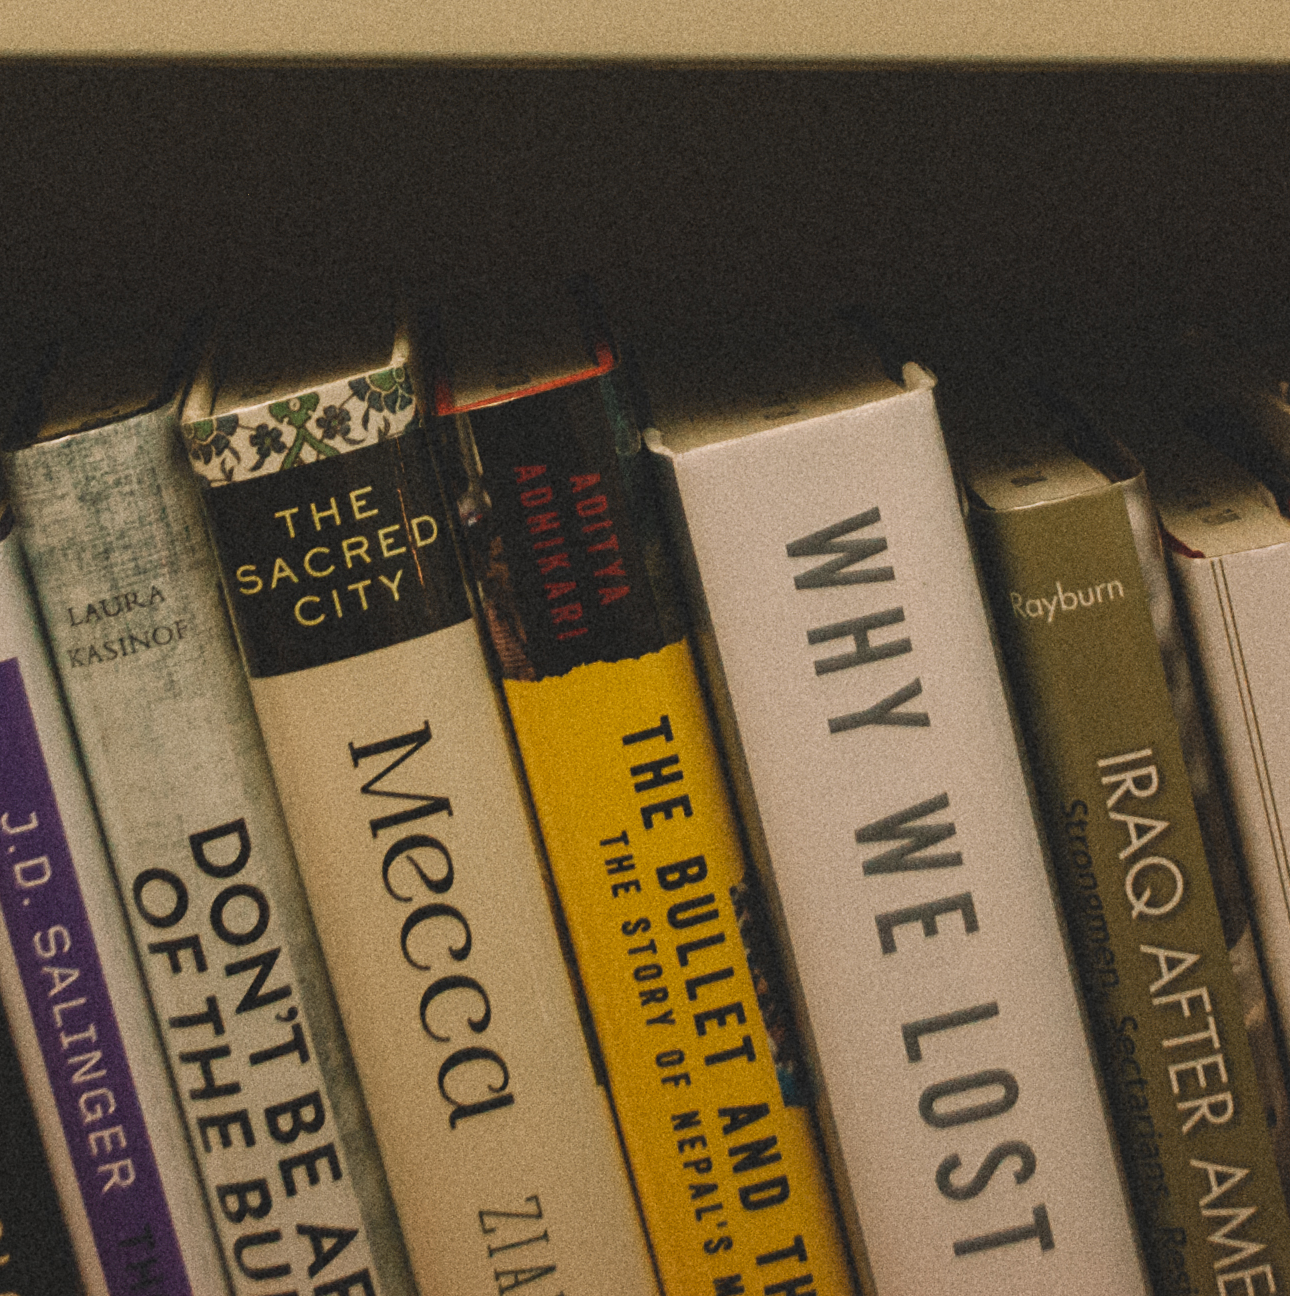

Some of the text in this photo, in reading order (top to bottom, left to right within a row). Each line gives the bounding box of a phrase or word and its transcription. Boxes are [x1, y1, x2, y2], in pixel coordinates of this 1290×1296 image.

[66, 585, 167, 627] LAURA
[235, 515, 440, 595] SACRED
[275, 486, 379, 538] THE
[293, 570, 406, 627] CITY
[514, 464, 588, 640] ADHIKARI
[569, 471, 631, 606] ADITYA
[1009, 577, 1126, 623] Rayburn
[67, 619, 190, 670] KASINOF
[348, 719, 515, 1130] Mecca
[622, 715, 790, 1213] THE BULLET AND
[786, 506, 1056, 1257] WHY WE LOST
[1097, 747, 1236, 1134] IRAQ AFTER
[33, 923, 136, 1195] SALINGER
[132, 867, 258, 1153] OF THE
[188, 817, 343, 1198] DON'T BE
[599, 829, 734, 1255] THE STORY OF NEPAL'S
